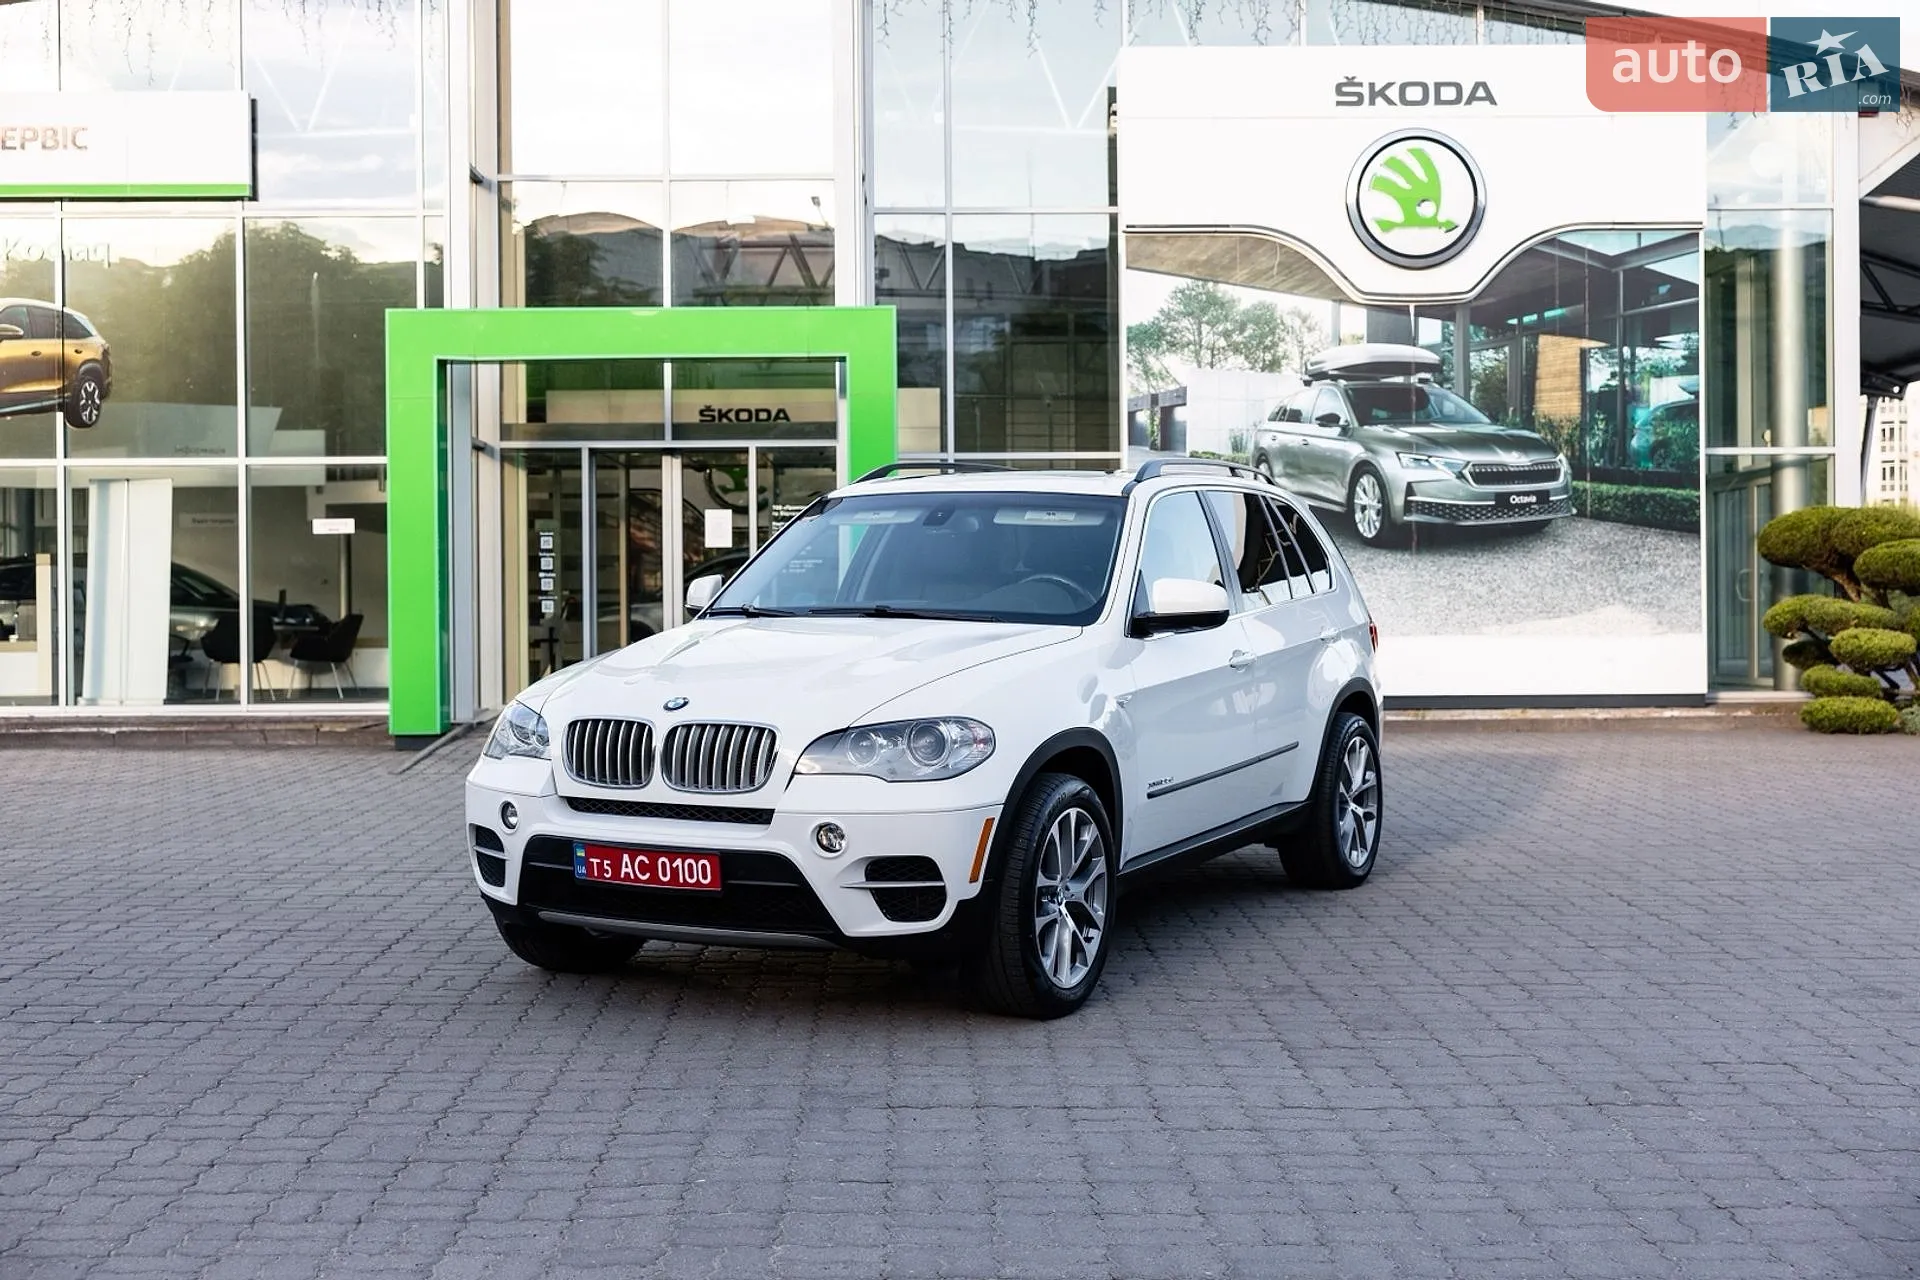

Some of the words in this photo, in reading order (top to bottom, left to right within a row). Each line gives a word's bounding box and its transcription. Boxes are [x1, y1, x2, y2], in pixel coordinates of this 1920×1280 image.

[1334, 76, 1498, 107] ŠKODA
[698, 404, 791, 423] ŠKODA
[1509, 493, 1538, 505] Octavia
[657, 856, 712, 885] 0100
